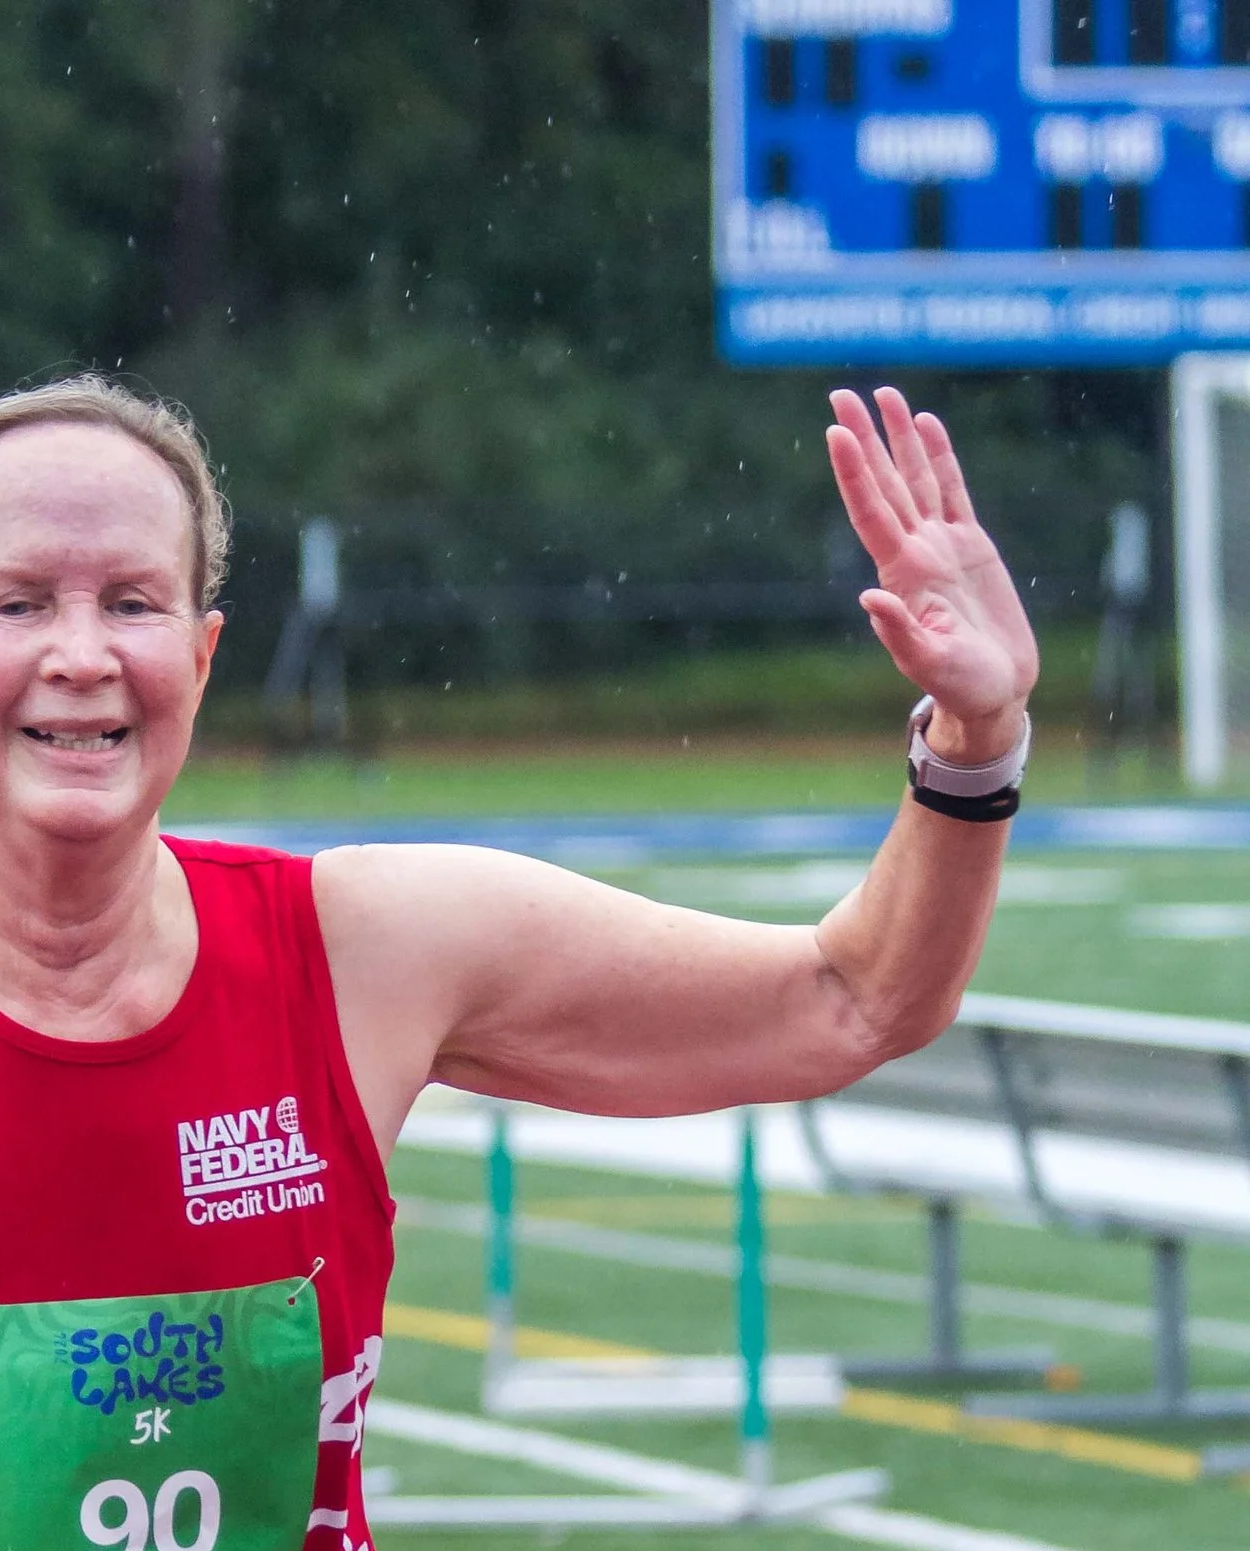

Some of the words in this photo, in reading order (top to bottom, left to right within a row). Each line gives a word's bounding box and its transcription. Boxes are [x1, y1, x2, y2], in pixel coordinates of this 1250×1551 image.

[178, 1106, 270, 1153] NAVY
[186, 1189, 264, 1225] Credit
[71, 1311, 223, 1364] SOUTH
[71, 1358, 225, 1415] LAKES
[130, 1407, 171, 1444] 5K
